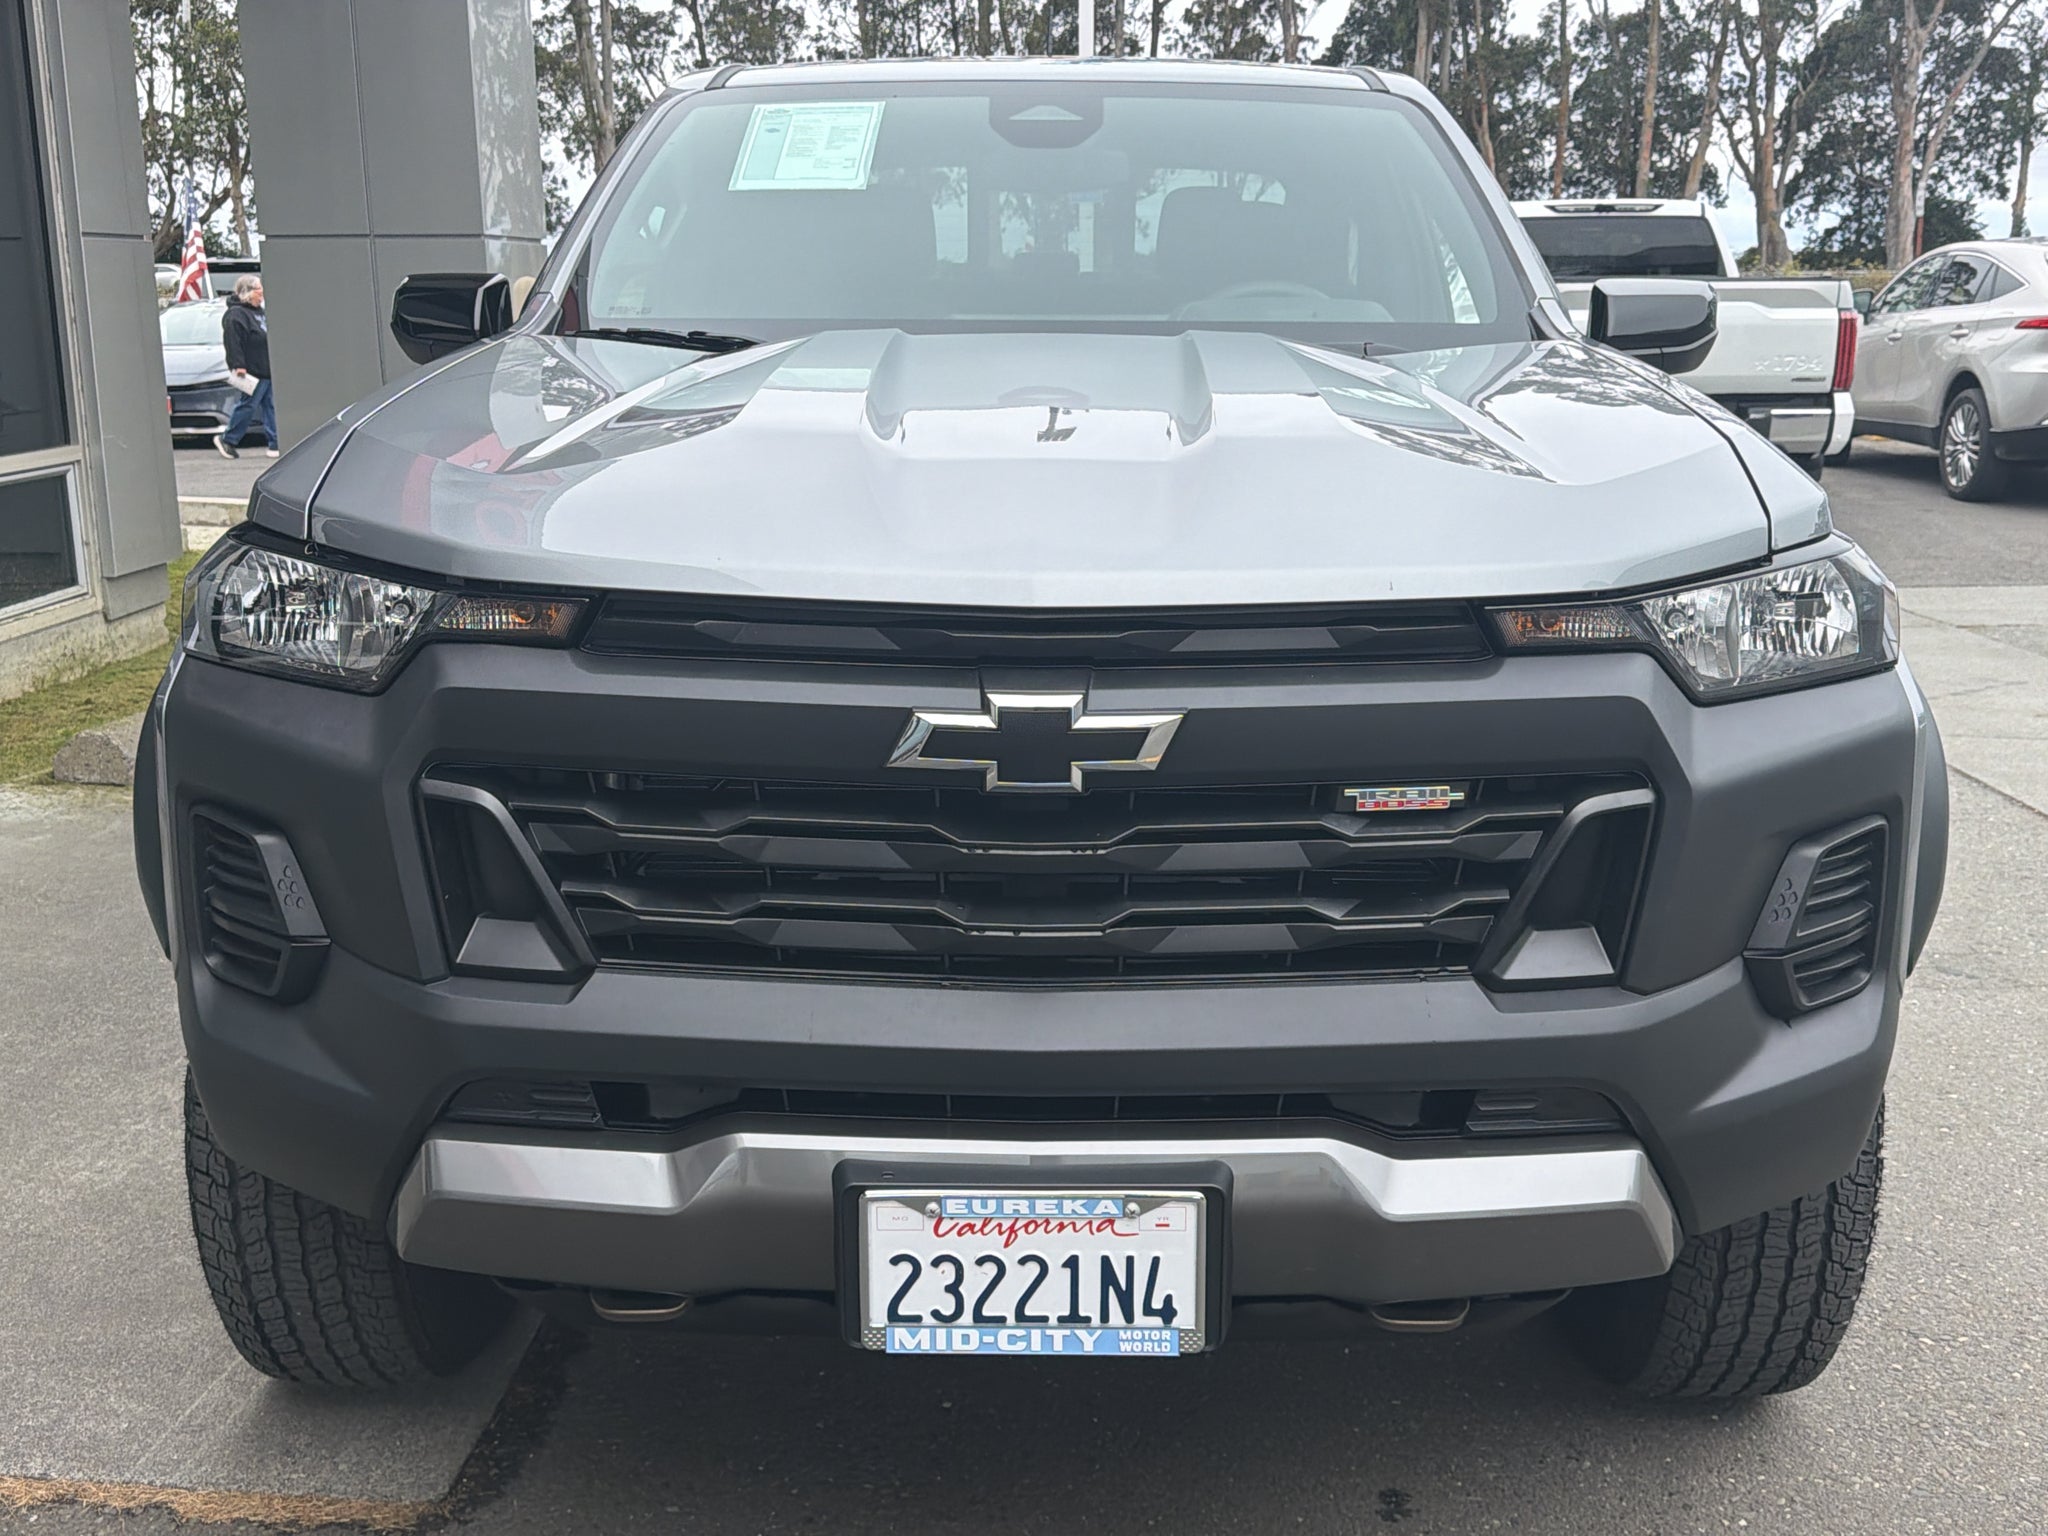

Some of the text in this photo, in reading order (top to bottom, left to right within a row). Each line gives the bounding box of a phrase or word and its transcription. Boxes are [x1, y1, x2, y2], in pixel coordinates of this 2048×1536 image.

[945, 1199, 1120, 1215] EUREKA
[932, 1216, 1140, 1249] California
[886, 1253, 1178, 1325] 23221N4
[893, 1328, 1103, 1352] MID-CITY
[1118, 1329, 1171, 1341] MOTOR
[1118, 1340, 1171, 1353] WORLD
